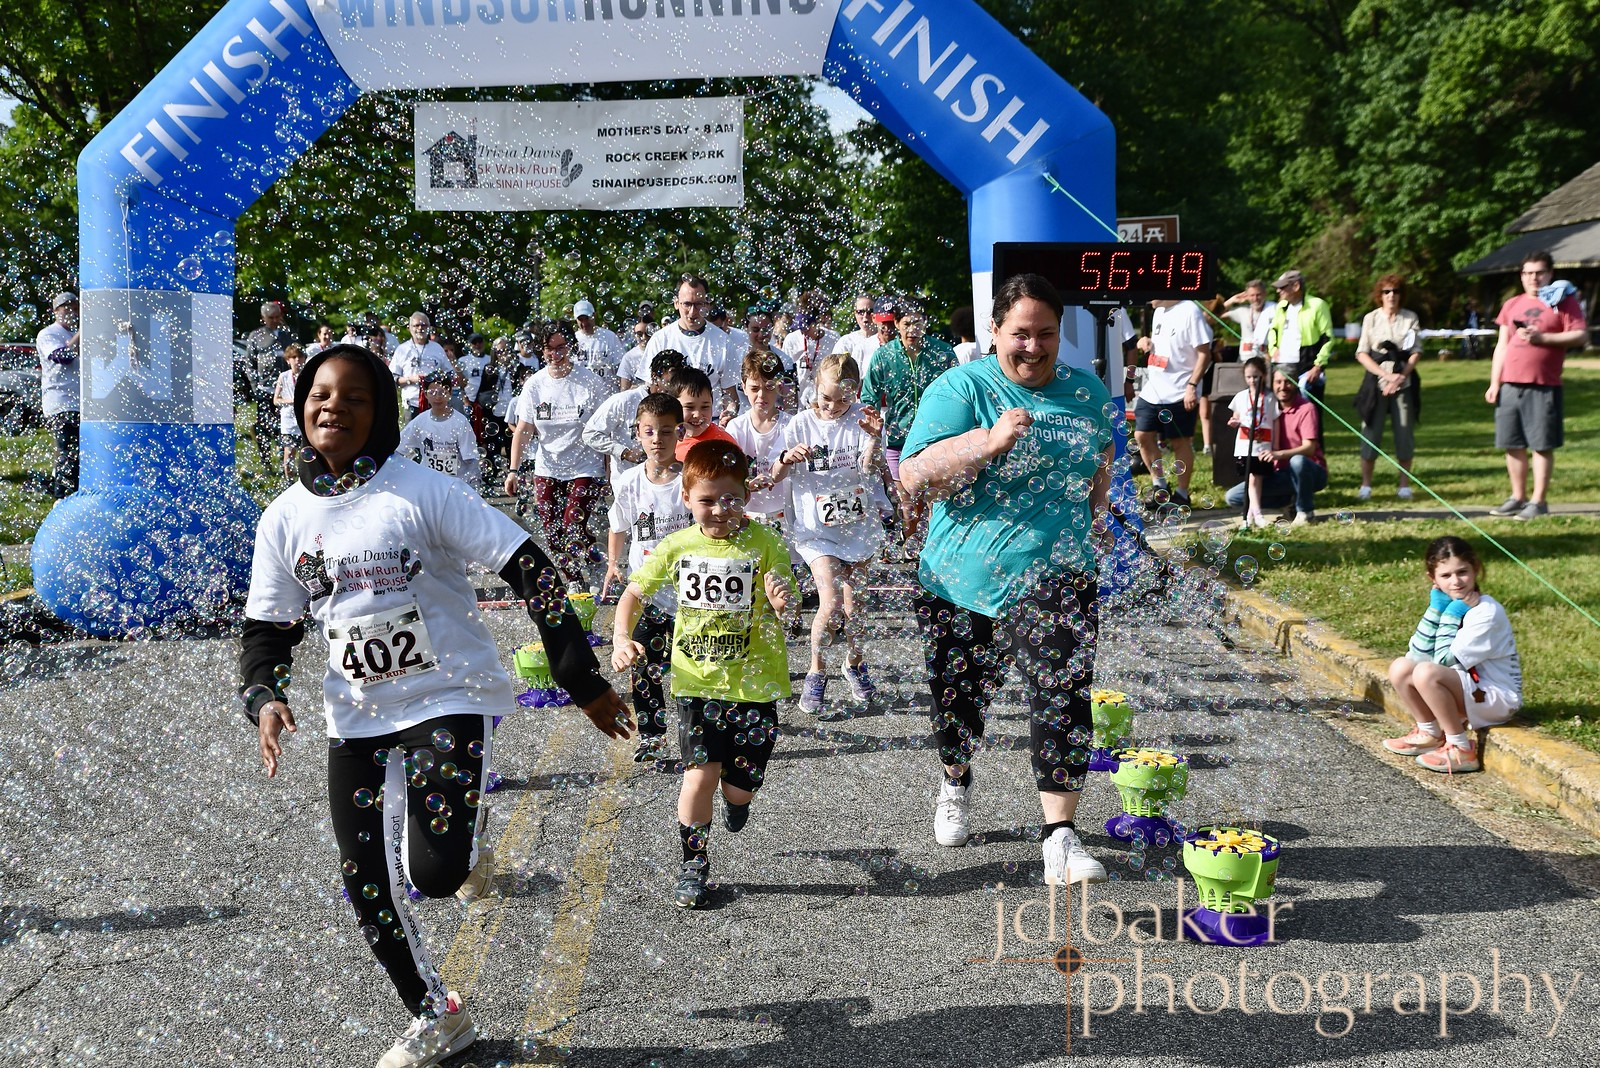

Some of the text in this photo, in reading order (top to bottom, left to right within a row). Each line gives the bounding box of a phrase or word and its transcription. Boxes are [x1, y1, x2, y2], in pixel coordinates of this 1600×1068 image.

[120, 0, 313, 187] FINISH
[597, 124, 734, 137] MOTHER'S DAY 8 AM
[478, 145, 561, 158] Tricia Davis
[605, 150, 725, 163] ROCK CREEK PARK
[478, 164, 491, 175] 5k
[496, 164, 557, 175] Walk/Run
[496, 179, 523, 188] SINAI
[526, 179, 561, 188] HOUSE
[592, 175, 737, 188] SINAIHOUSEDC5K.COM
[822, 496, 863, 522] 254
[326, 548, 399, 570] Tricia Davis
[343, 565, 399, 579] Walk/Run
[348, 581, 373, 592] SINAI
[374, 575, 406, 588] HOUSE
[686, 572, 744, 604] 369
[342, 630, 423, 679] 402
[362, 668, 407, 684] FUN RUN
